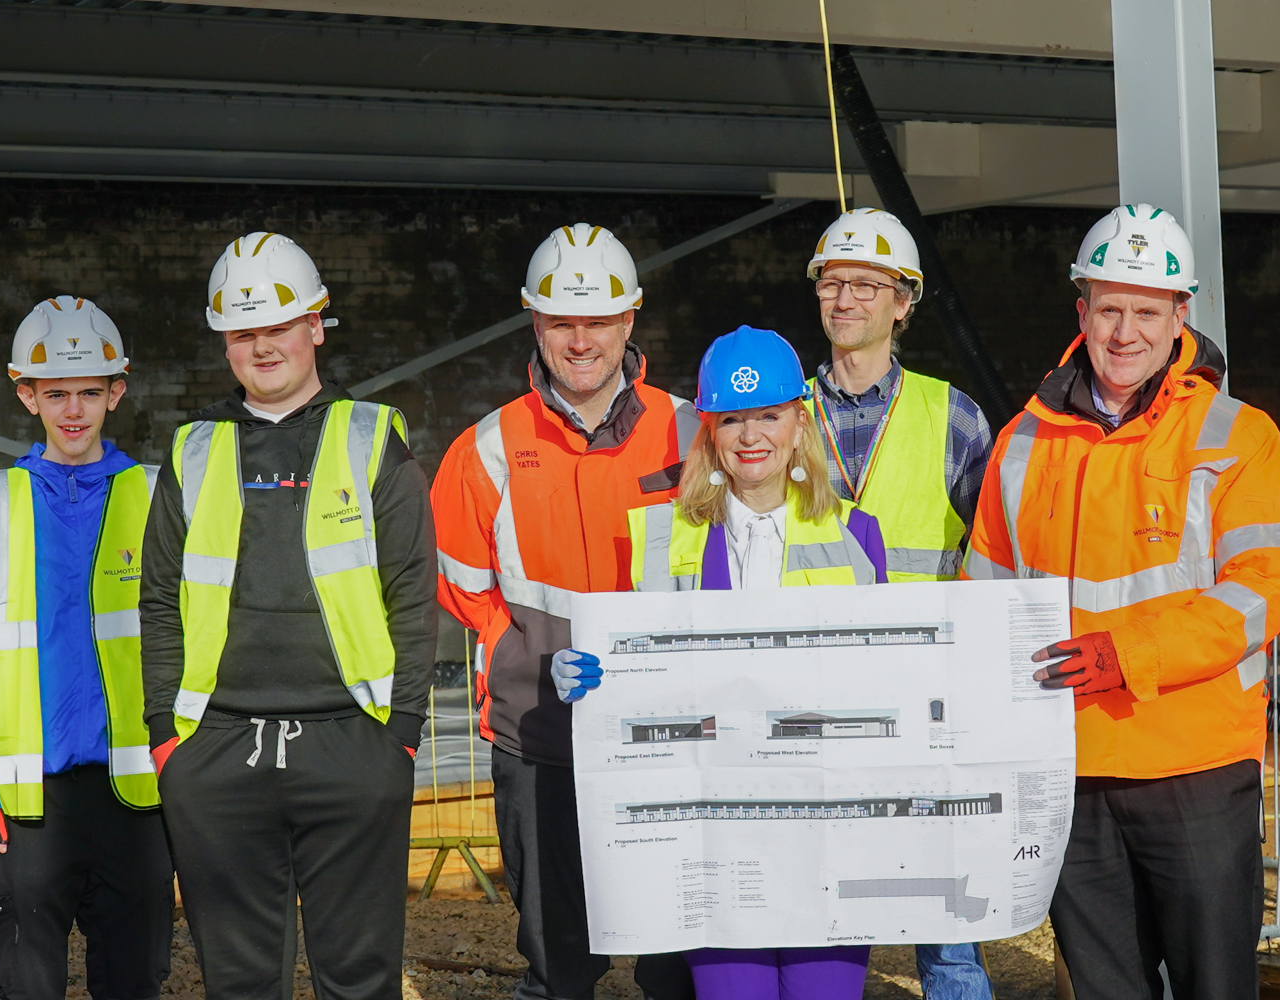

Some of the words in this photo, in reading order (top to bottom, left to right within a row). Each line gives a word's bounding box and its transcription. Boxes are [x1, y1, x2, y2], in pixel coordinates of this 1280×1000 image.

[515, 450, 538, 459] CHRIS
[516, 460, 540, 469] YATES
[255, 472, 311, 483] ARIS
[321, 507, 354, 520] WILLMOTT
[103, 567, 134, 575] WILLMOTT
[1013, 845, 1041, 861] AHR
